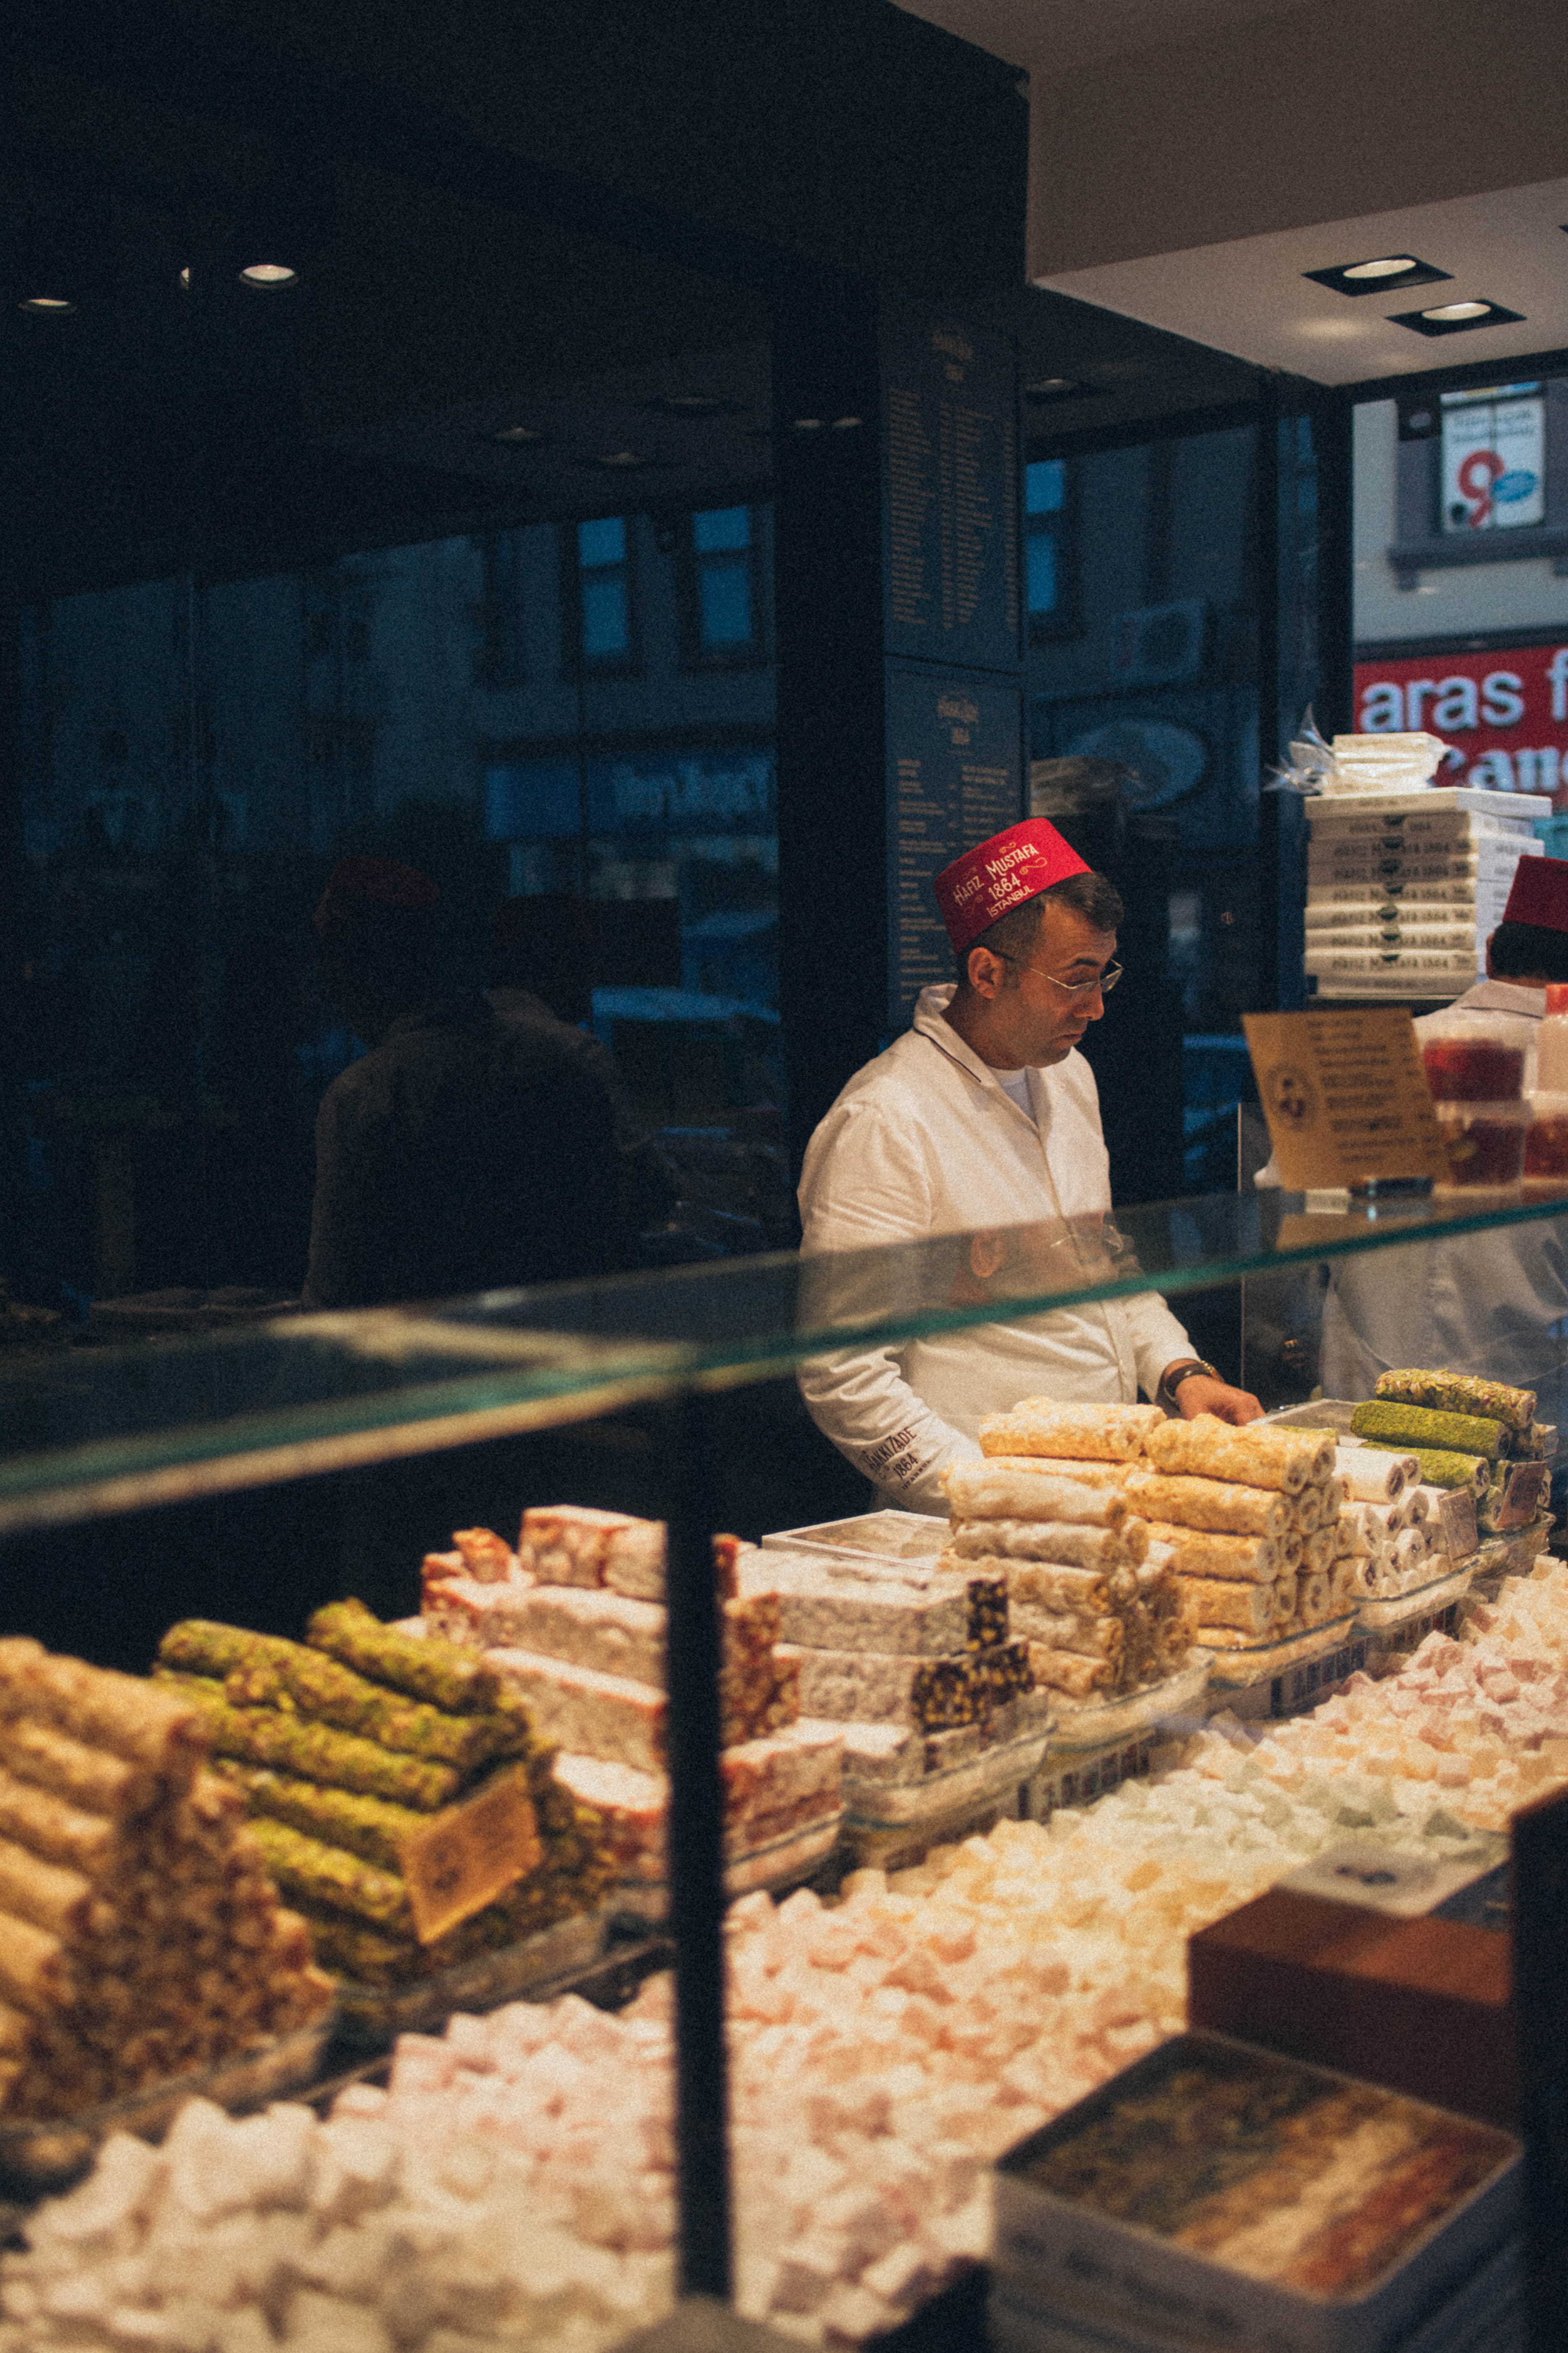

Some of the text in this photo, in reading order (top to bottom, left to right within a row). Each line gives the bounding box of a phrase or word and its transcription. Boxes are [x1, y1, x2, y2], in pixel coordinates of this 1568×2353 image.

[1361, 671, 1524, 733] aras
[953, 843, 1039, 906] HAFIZ MUSTAFA
[988, 873, 1021, 900] 1864
[892, 1452, 918, 1480] 1864
